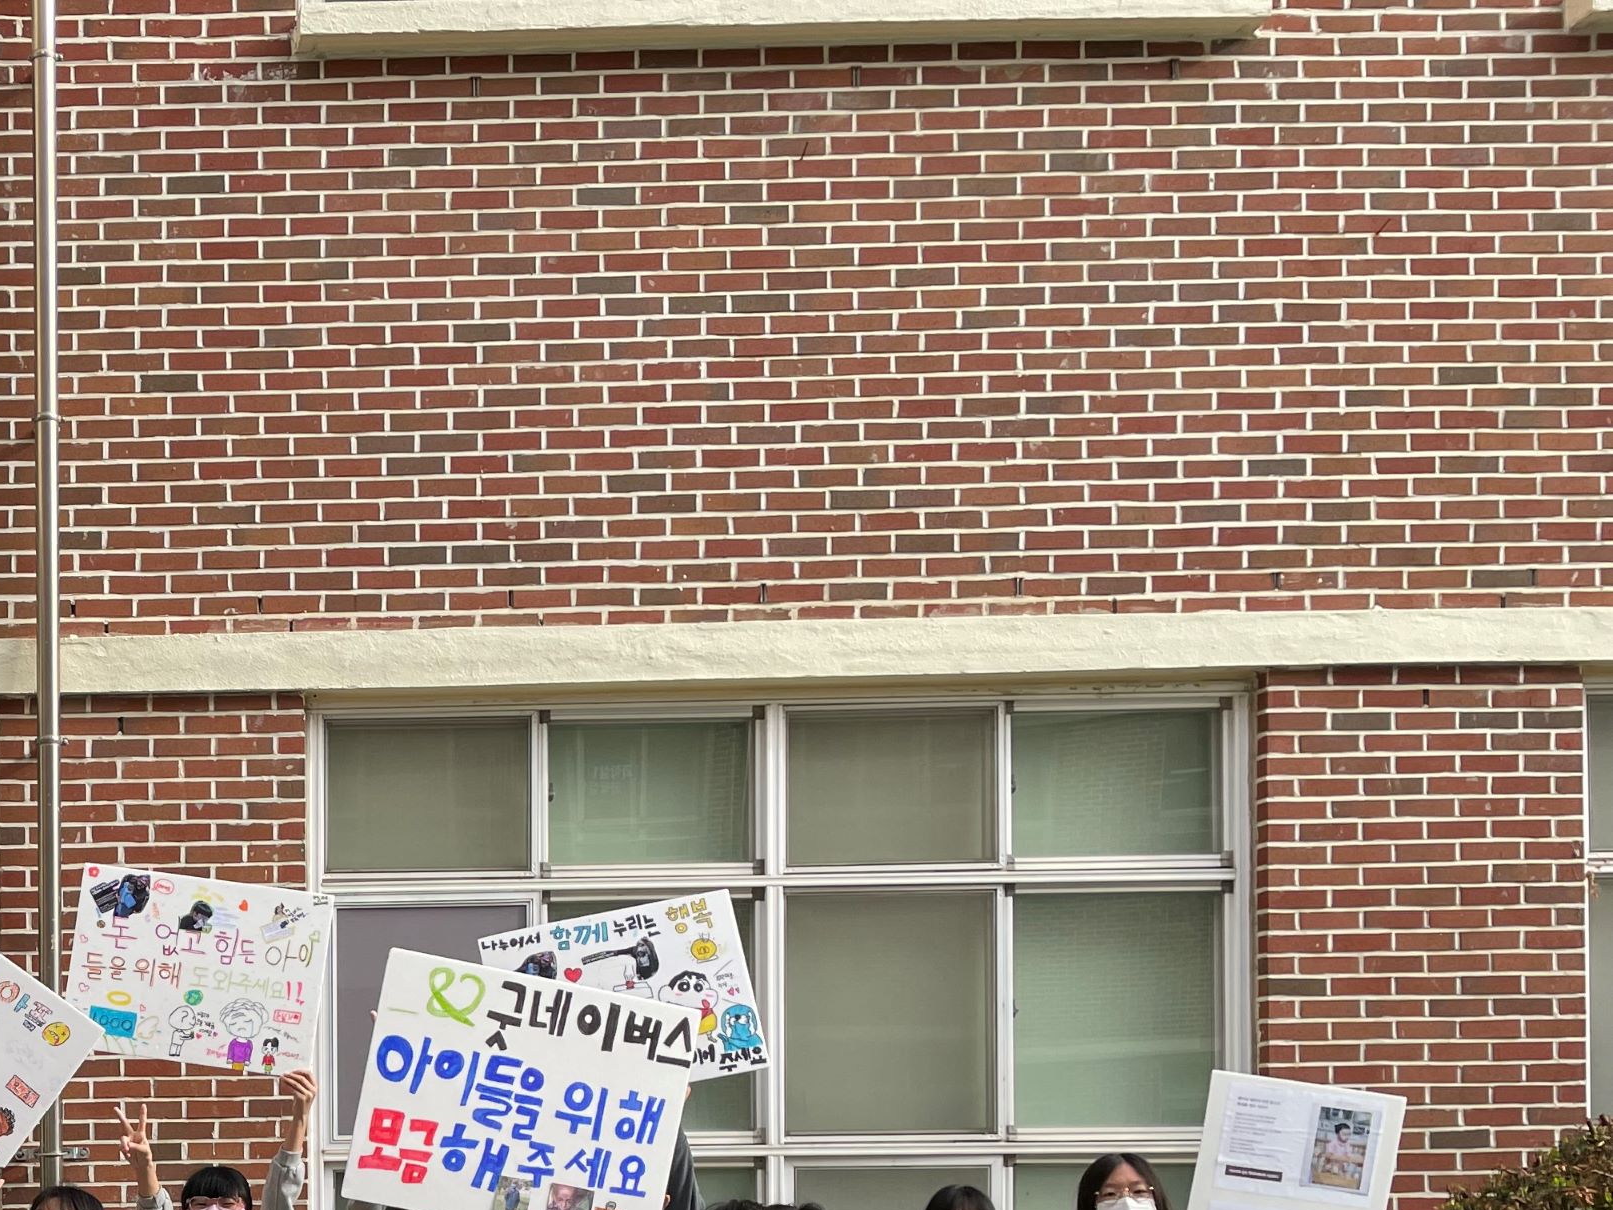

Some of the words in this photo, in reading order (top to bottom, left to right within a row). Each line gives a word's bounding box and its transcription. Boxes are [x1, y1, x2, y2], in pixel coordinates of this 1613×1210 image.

[102, 916, 137, 949] 돈
[155, 916, 206, 956] 없고
[214, 928, 255, 965] 힘든
[481, 932, 541, 952] 나누어서
[550, 921, 609, 951] 함께
[613, 914, 662, 938] 누리는
[665, 897, 714, 934] 행복
[82, 952, 127, 980] 들을
[133, 957, 183, 989] 위해
[485, 980, 692, 1068] 굿네이버스
[719, 1046, 767, 1072] 주세요
[376, 1034, 545, 1142] 아이들을
[554, 1080, 667, 1145] 위해
